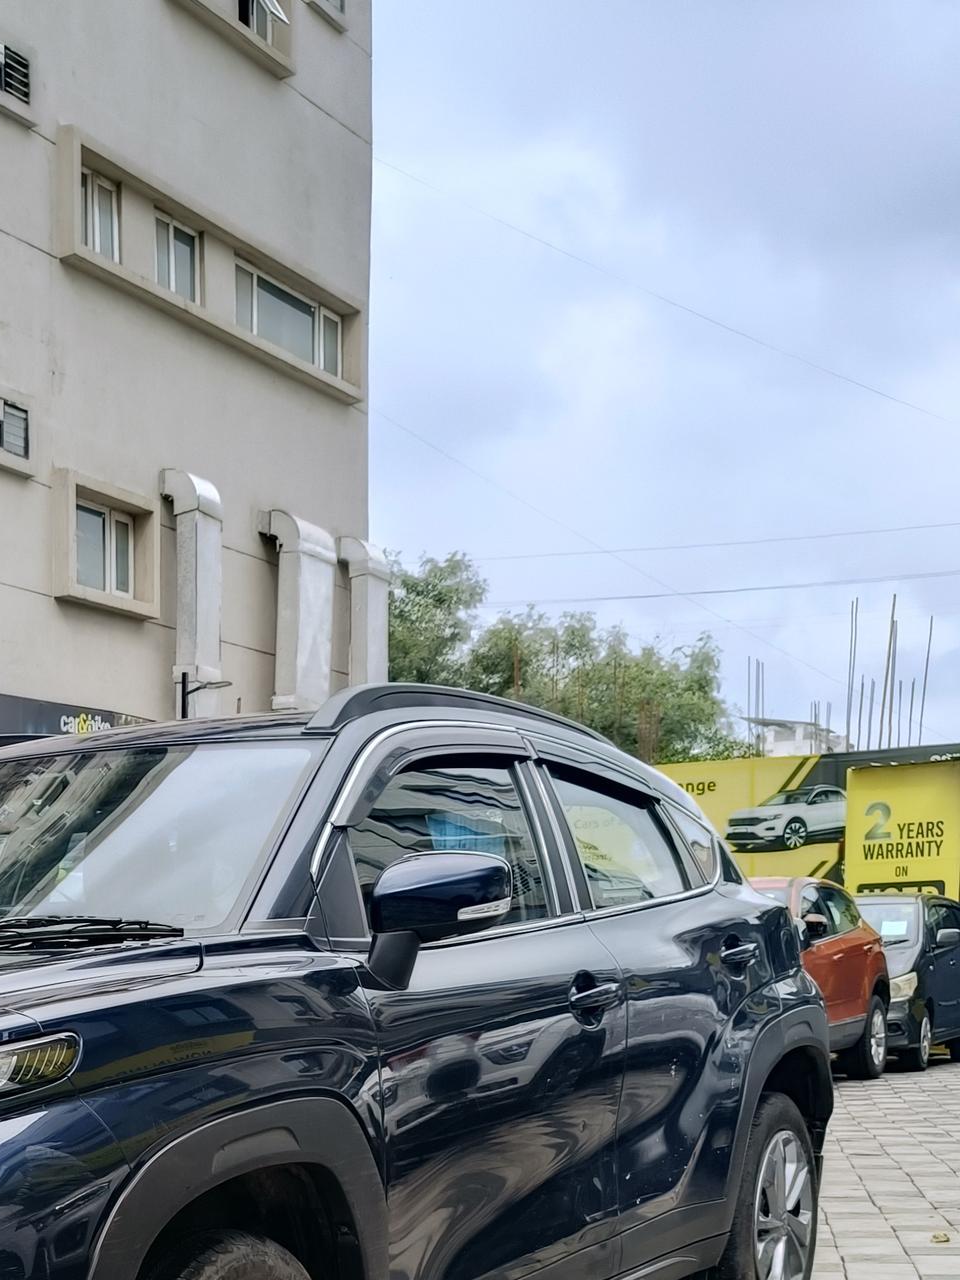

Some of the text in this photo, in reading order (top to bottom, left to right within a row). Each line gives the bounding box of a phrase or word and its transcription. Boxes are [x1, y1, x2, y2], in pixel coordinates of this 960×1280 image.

[864, 801, 945, 841] 2 YEARS
[863, 839, 944, 861] WARRANTY
[895, 865, 909, 878] ON
